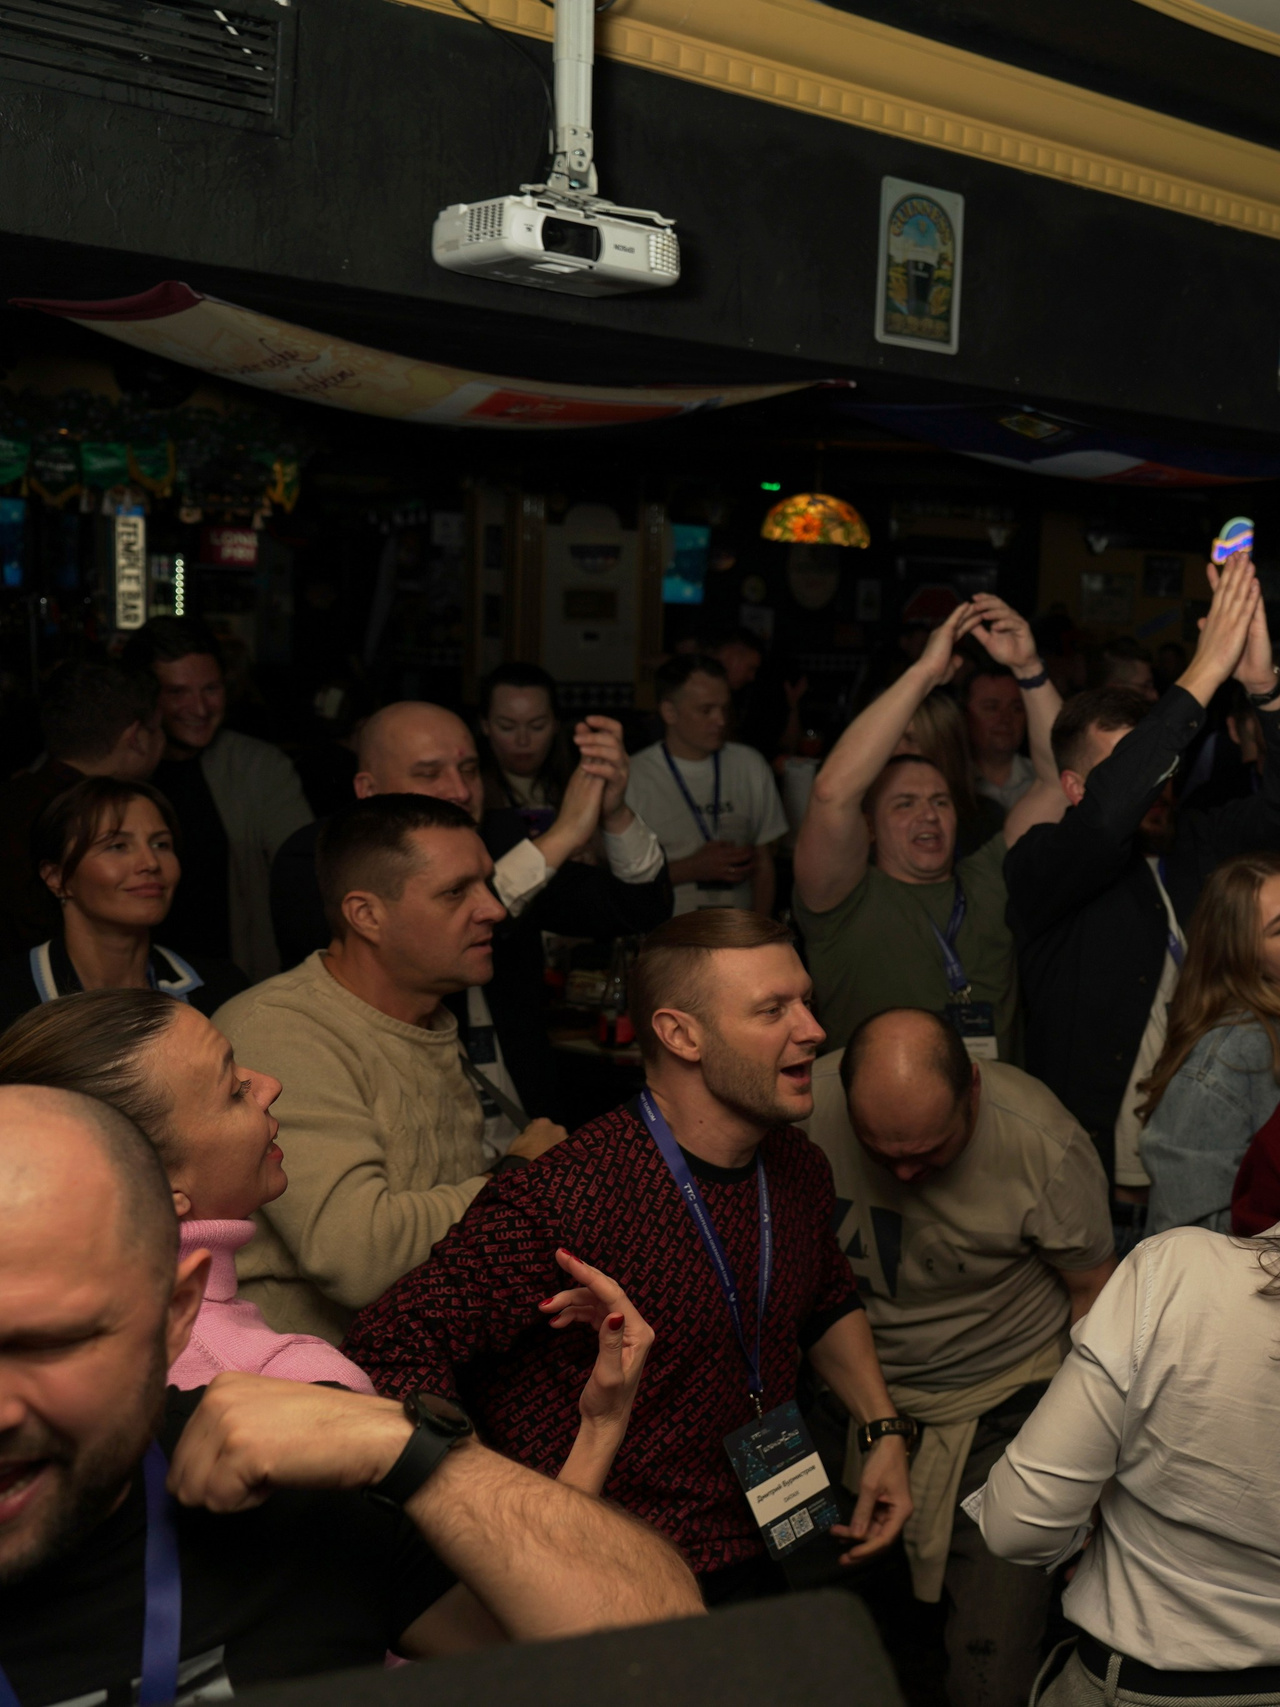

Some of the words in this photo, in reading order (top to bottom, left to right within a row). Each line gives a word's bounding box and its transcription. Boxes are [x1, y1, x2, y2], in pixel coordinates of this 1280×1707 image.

[890, 200, 951, 246] GUINNESS
[119, 521, 140, 585] TEMPLE
[119, 590, 140, 623] BAR
[632, 1151, 649, 1180] LUCKY
[567, 1176, 588, 1210] LUCKY
[634, 1171, 651, 1199] LUCKY
[654, 1181, 672, 1211] LUCKY
[495, 1230, 533, 1241] LUCKY
[498, 1252, 536, 1264] LUCKY
[756, 1485, 782, 1504] Дмитрий
